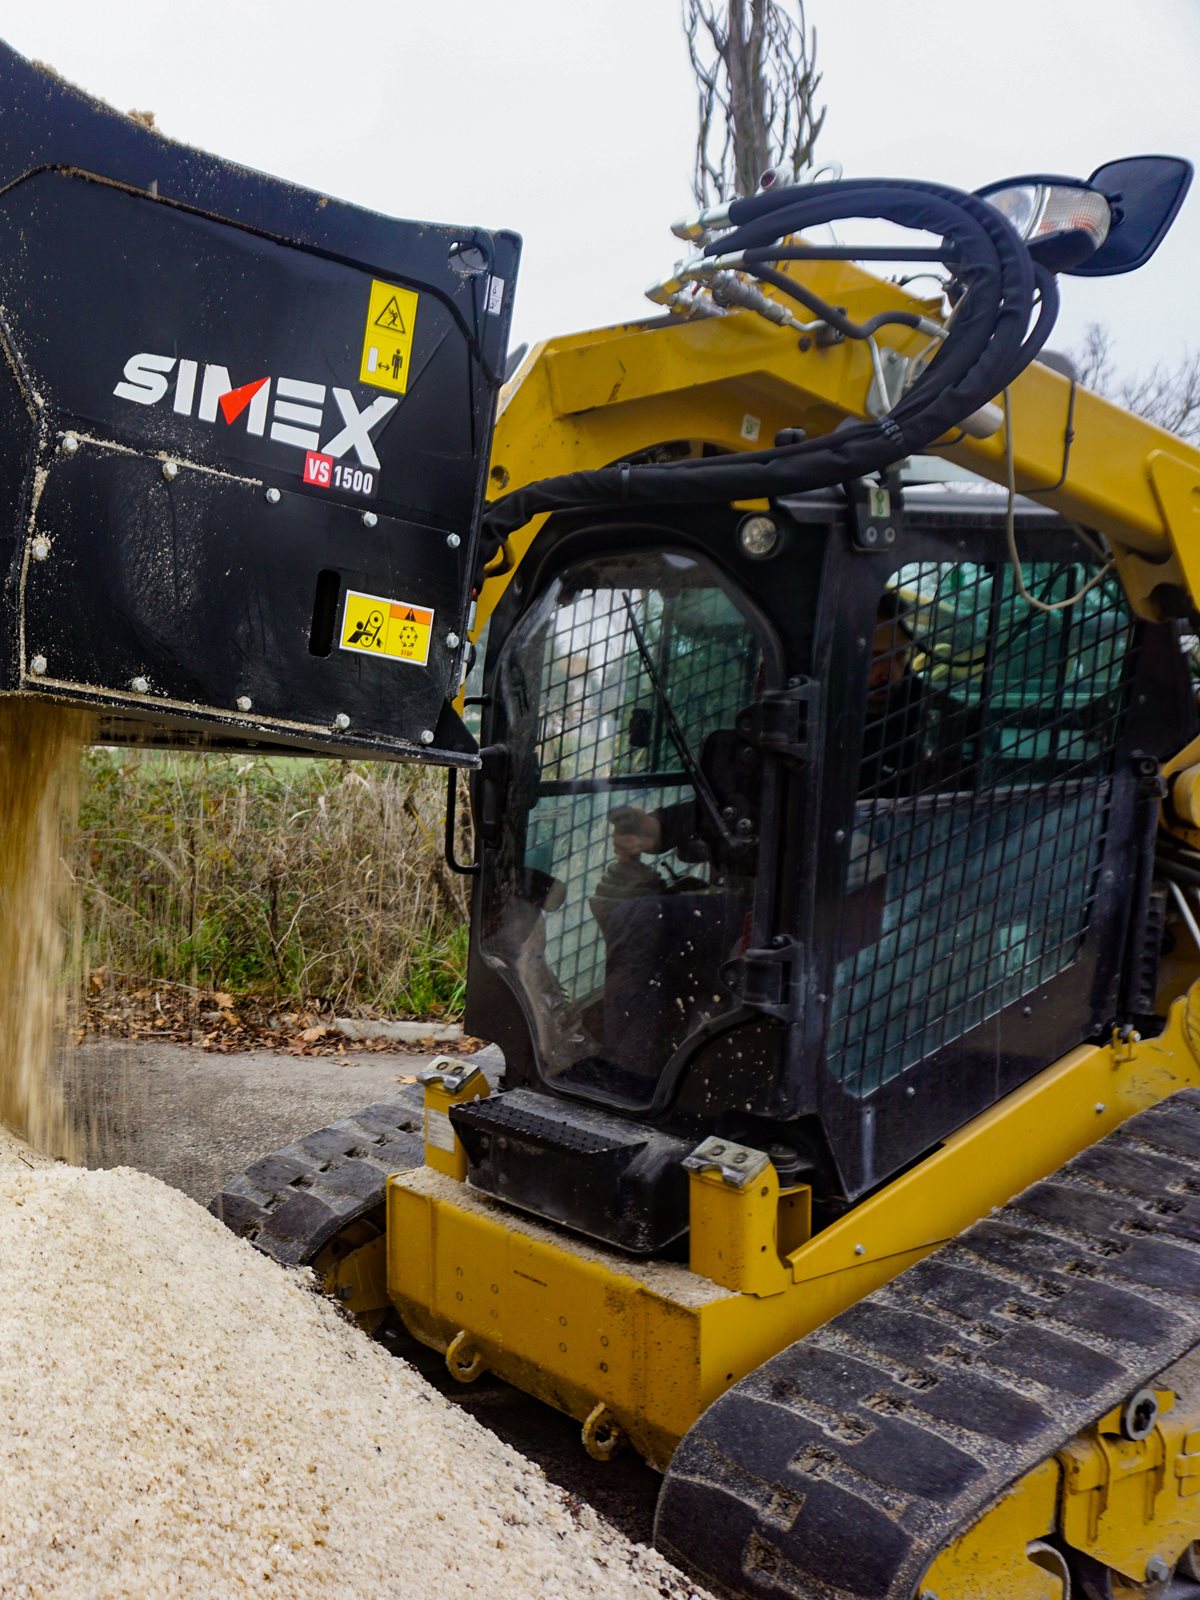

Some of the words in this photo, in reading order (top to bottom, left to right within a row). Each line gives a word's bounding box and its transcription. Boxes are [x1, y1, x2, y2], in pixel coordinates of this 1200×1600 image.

[112, 352, 399, 470] SIMEX
[308, 457, 330, 483] VS
[334, 465, 374, 495] 1500
